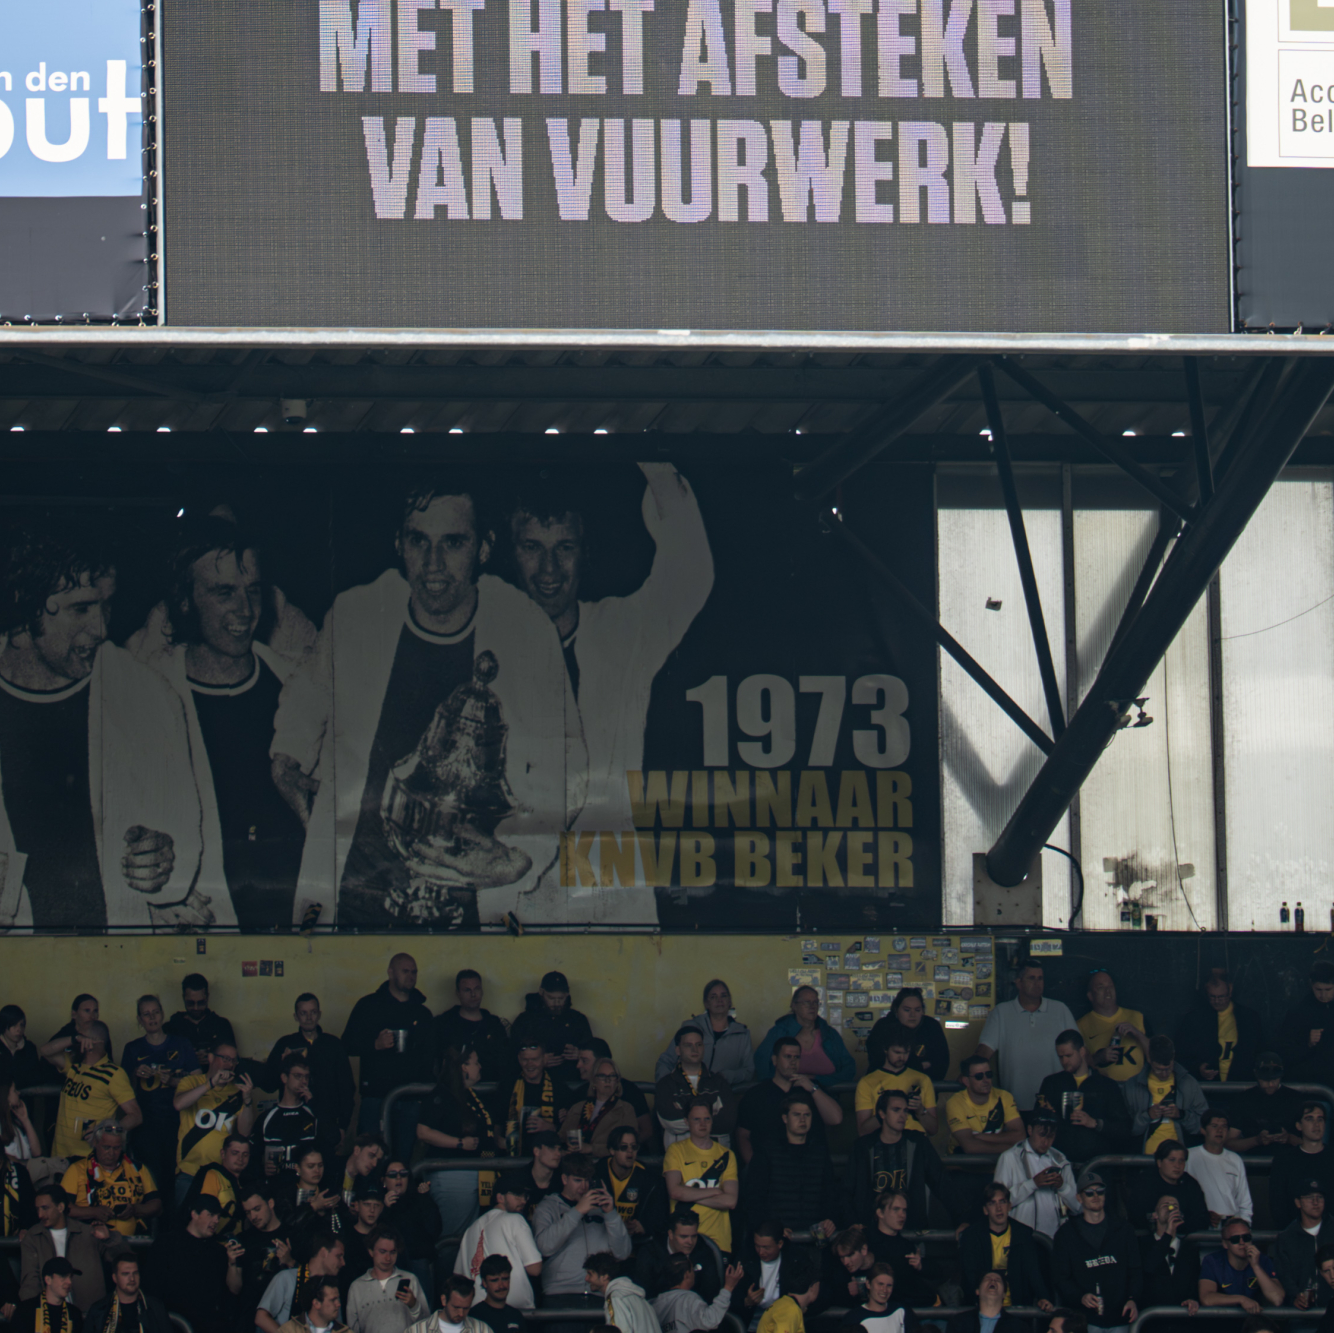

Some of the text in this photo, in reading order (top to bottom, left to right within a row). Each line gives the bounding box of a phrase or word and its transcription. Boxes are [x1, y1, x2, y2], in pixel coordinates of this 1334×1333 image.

[25, 62, 91, 91] den
[361, 117, 1031, 224] VAN VUURWERK!
[685, 674, 910, 768] 1973
[626, 770, 914, 828] WINNAAR
[559, 830, 914, 888] KNVB BEKER
[194, 1108, 236, 1132] OK
